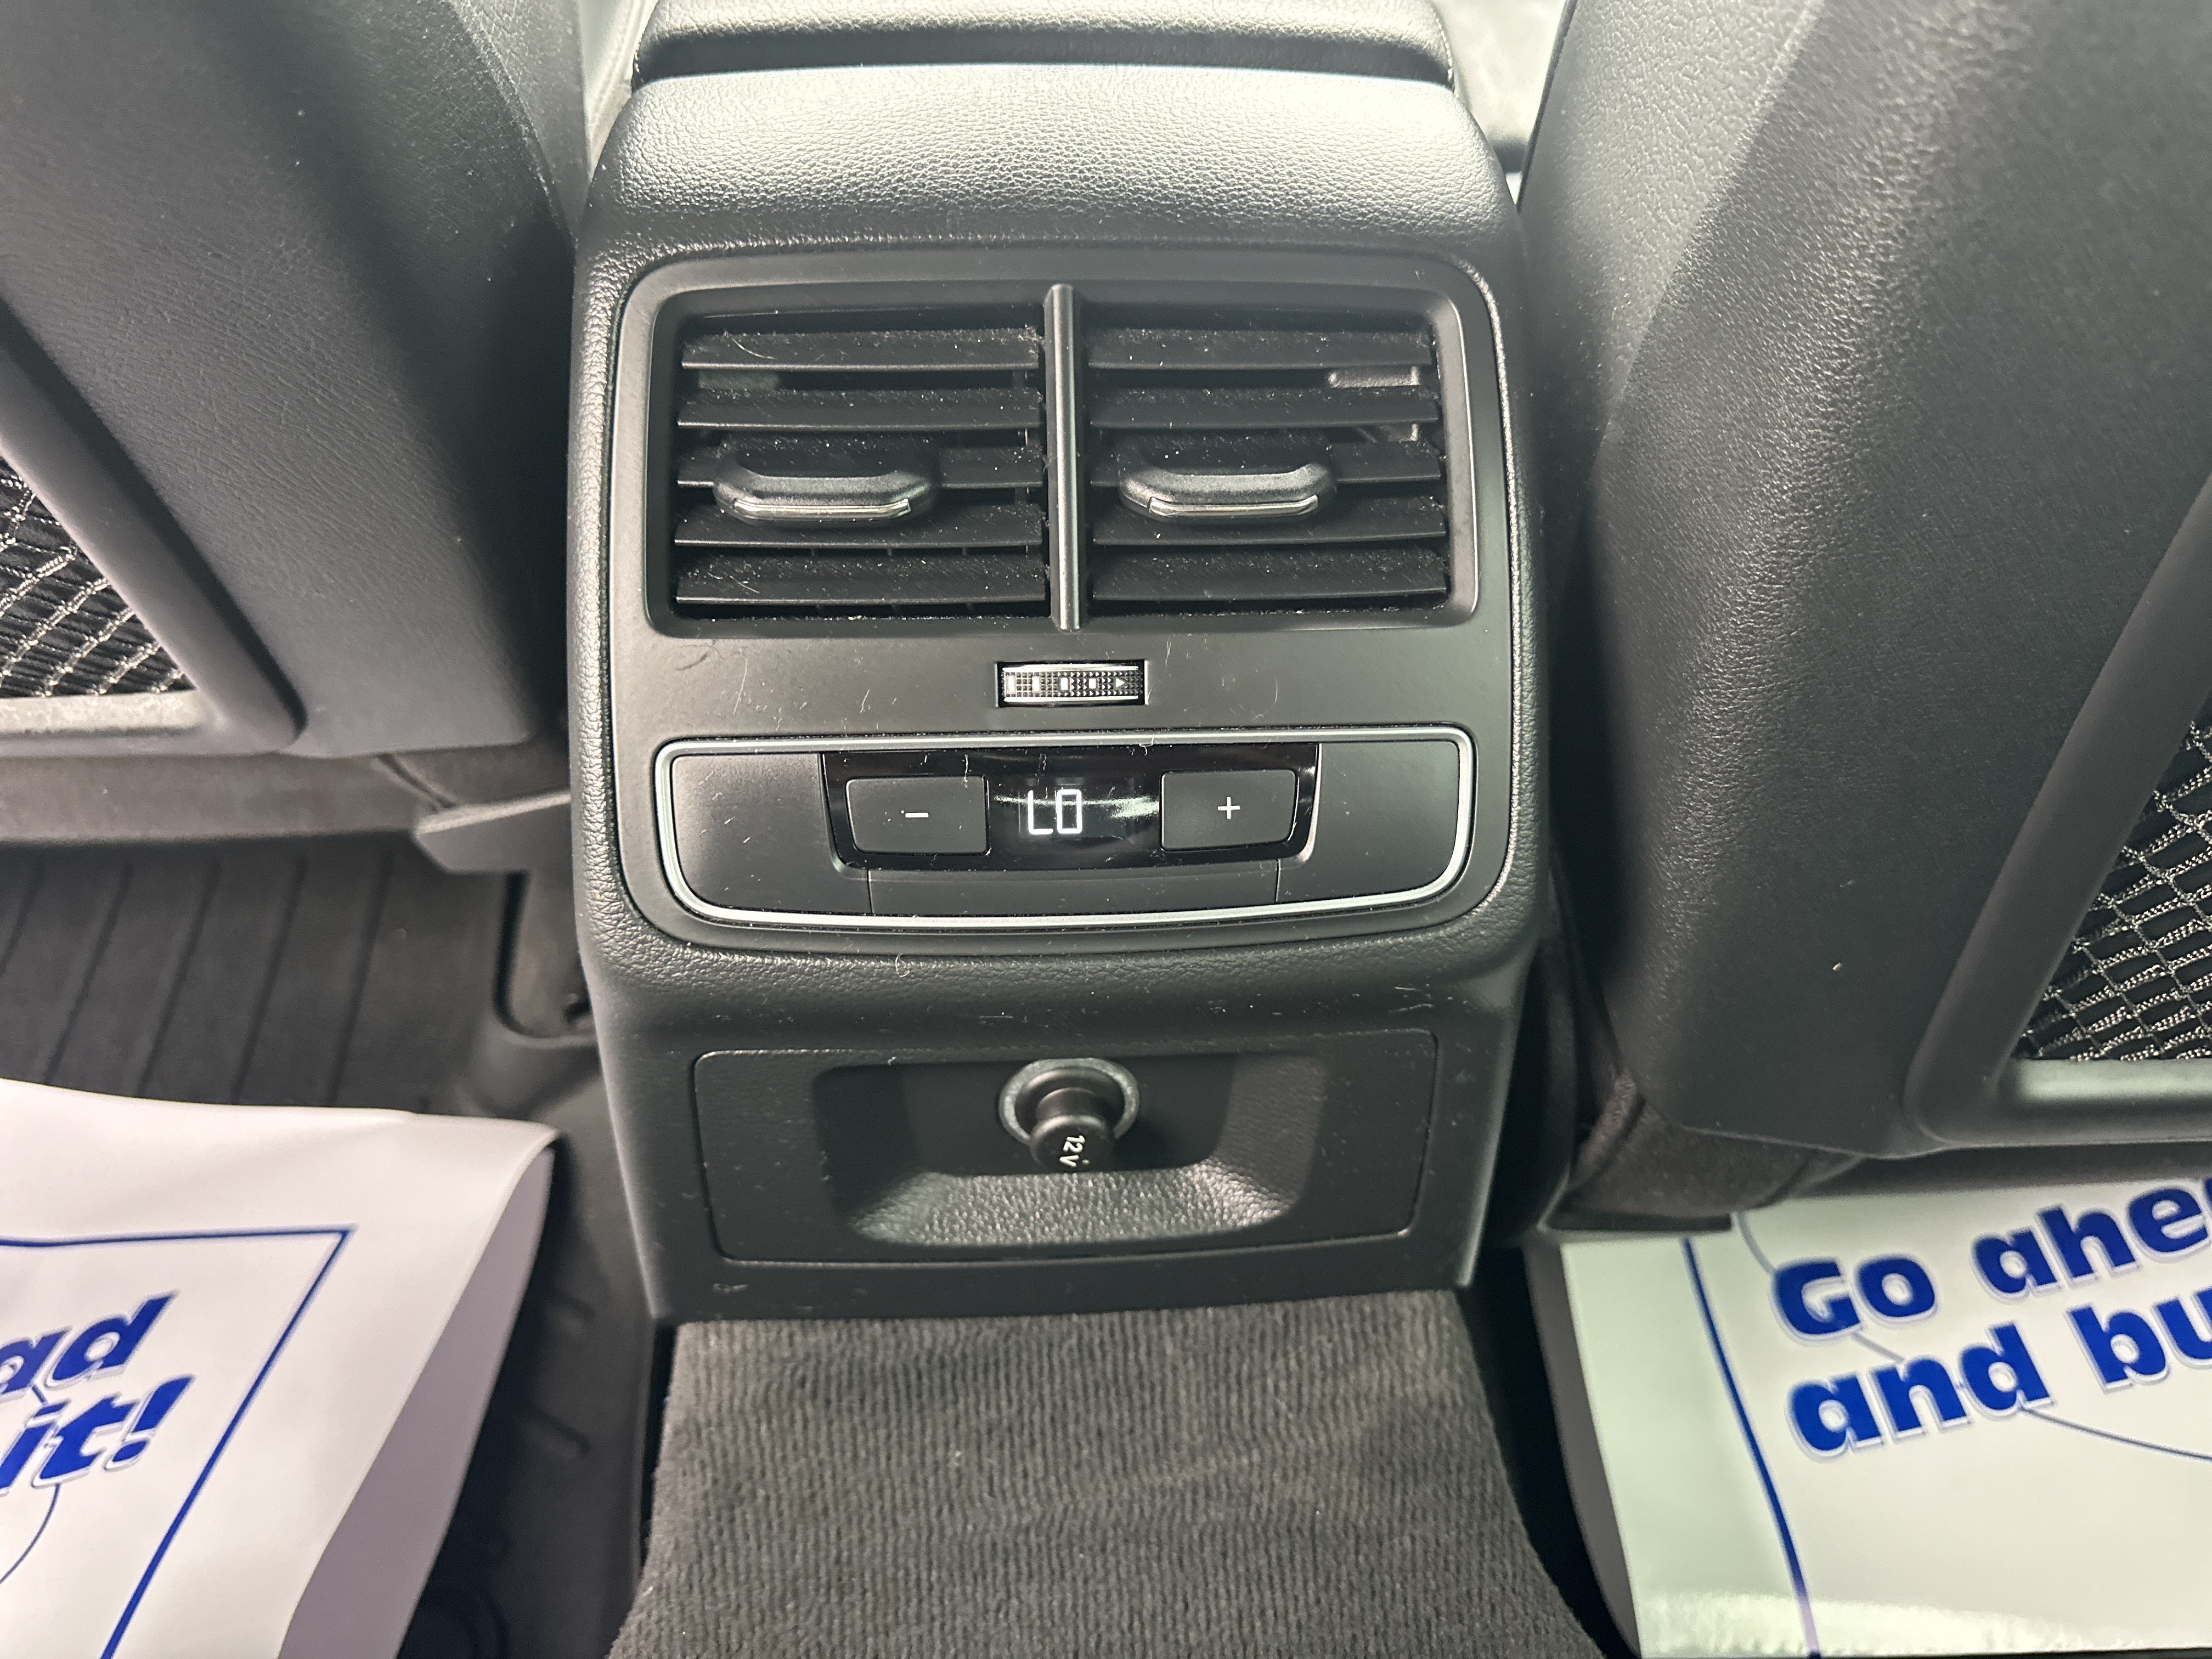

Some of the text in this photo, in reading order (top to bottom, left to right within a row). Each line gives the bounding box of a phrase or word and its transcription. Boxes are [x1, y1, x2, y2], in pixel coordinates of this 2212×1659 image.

[1027, 788, 1082, 835] LO
[1059, 1135, 1086, 1168] 12V
[1772, 1176, 2212, 1339] Go ahe
[0, 1375, 194, 1491] it!
[1788, 1321, 2053, 1454] and
